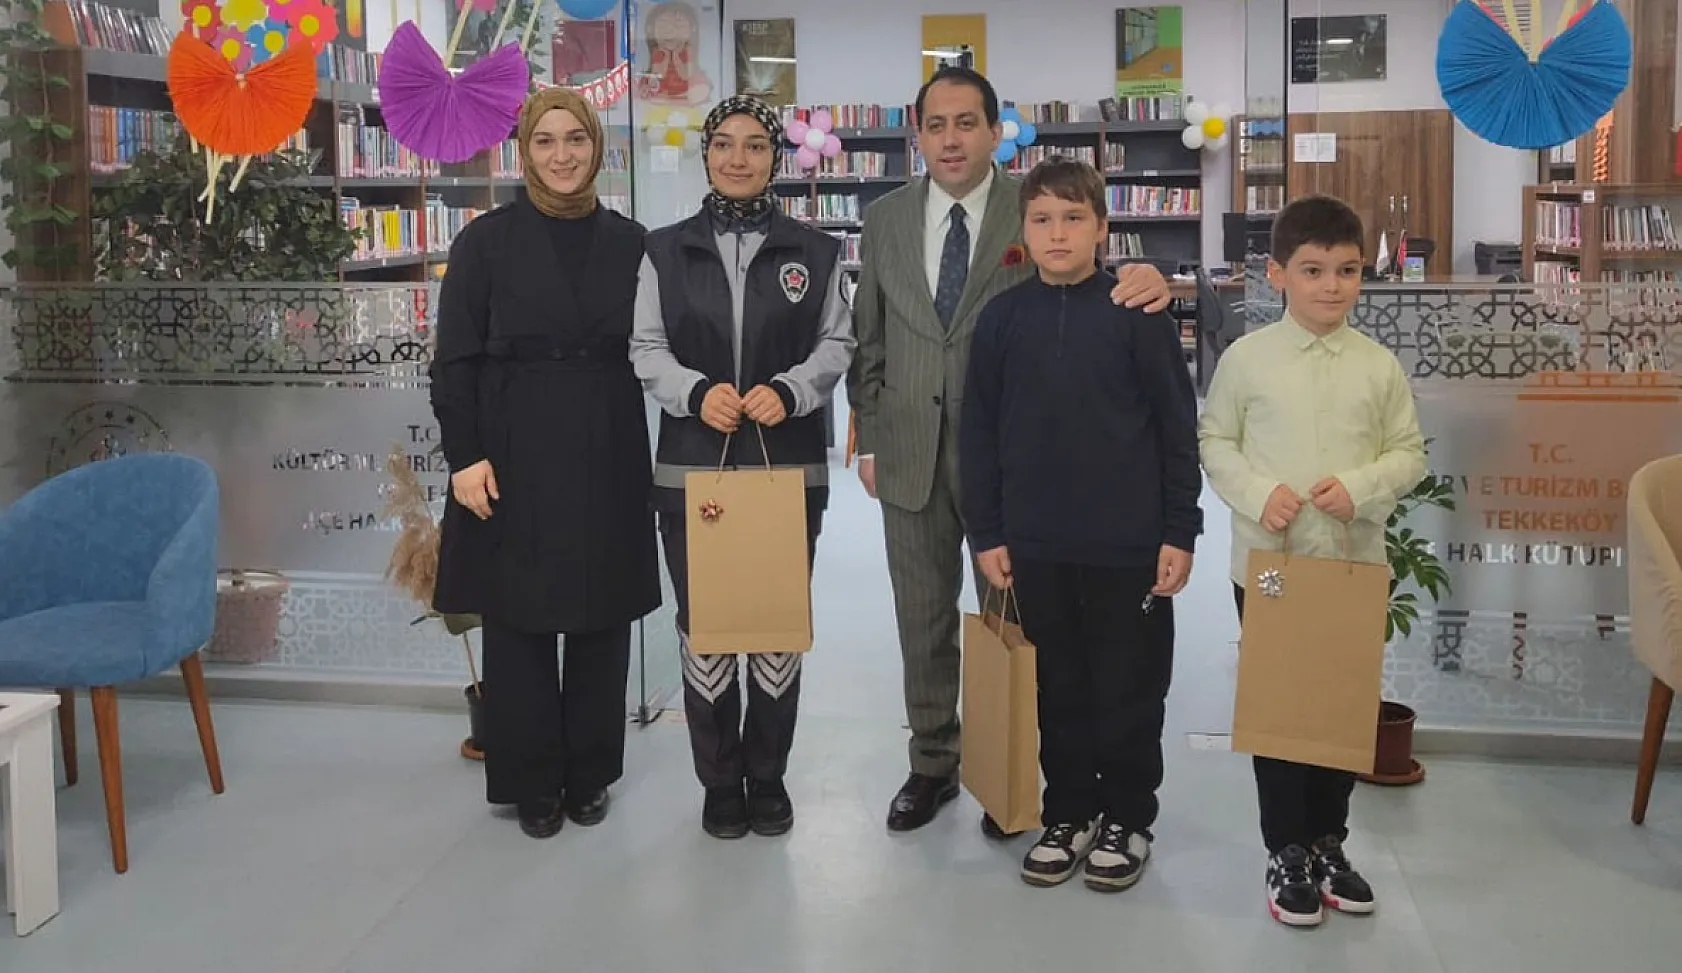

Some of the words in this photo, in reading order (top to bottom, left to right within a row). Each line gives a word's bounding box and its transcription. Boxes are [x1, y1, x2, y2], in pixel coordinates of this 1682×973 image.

[407, 424, 439, 442] T.C
[1529, 443, 1574, 464] T.C.
[1499, 474, 1599, 499] TURİZM
[1482, 507, 1618, 533] TEKKEKÖY
[1447, 542, 1519, 565] HALK
